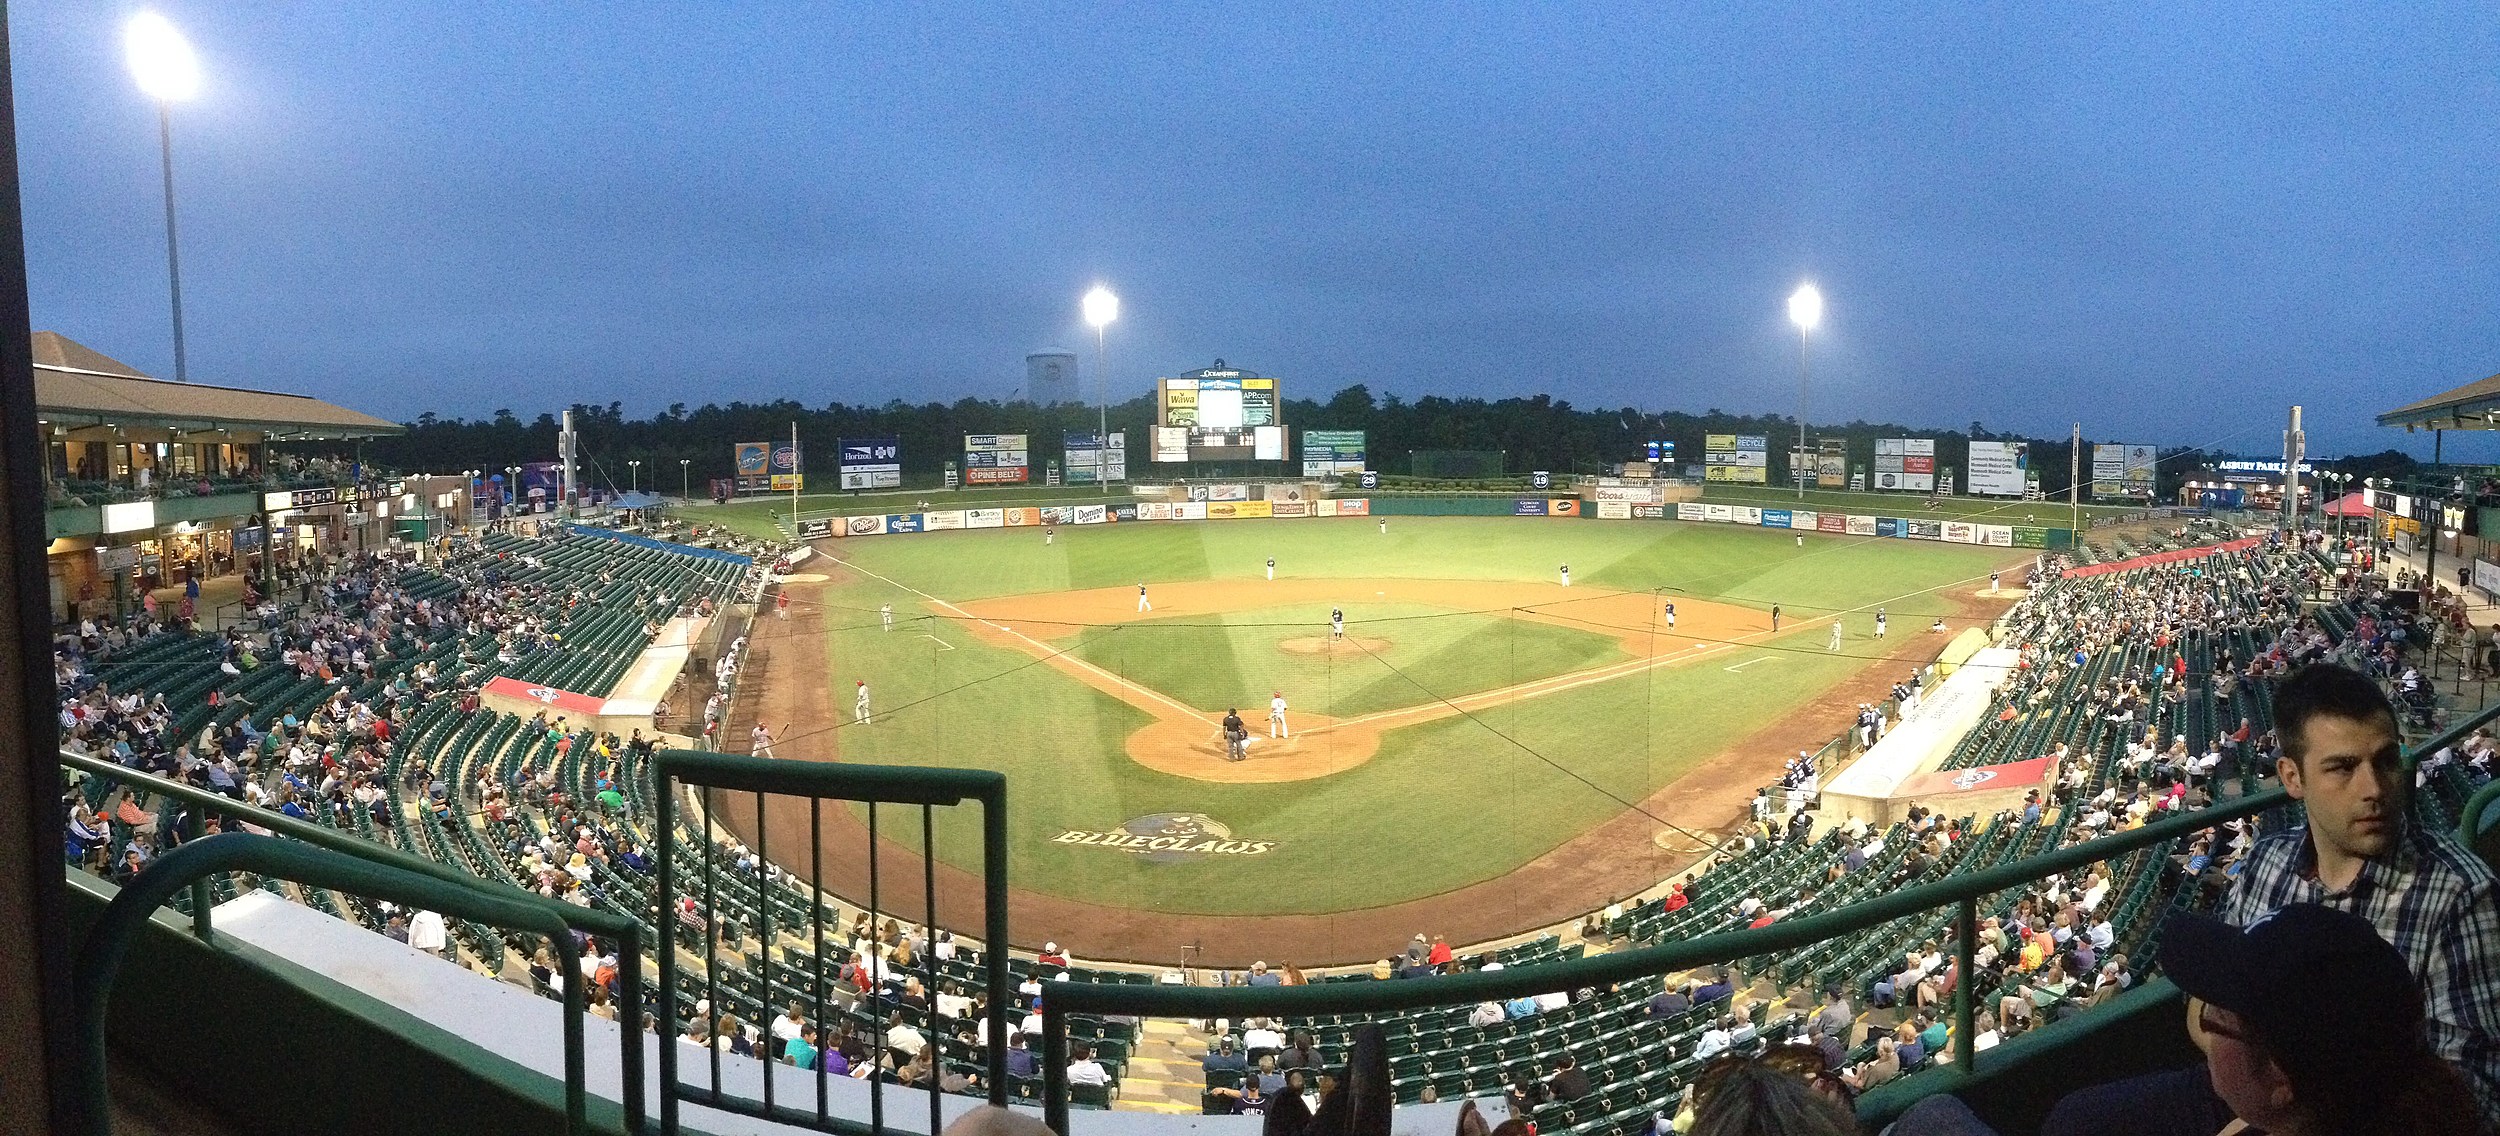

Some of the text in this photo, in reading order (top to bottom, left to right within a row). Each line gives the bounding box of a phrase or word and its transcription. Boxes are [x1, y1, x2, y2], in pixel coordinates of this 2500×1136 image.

[1171, 394, 1195, 404] Wawa
[1243, 392, 1272, 400] APP.com
[972, 437, 1019, 446] SMART Carpet
[1737, 439, 1767, 448] RECYCLE
[845, 452, 872, 461] Horizon
[1820, 464, 1843, 476] Coors
[2219, 461, 2255, 471] ASBURY
[2256, 462, 2281, 472] PARK
[977, 471, 1015, 479] PINE BELT
[1362, 475, 1375, 485] 29
[1535, 476, 1547, 485] 19
[1597, 490, 1624, 500] Coors
[1078, 507, 1104, 520] Domino
[892, 520, 917, 529] Corona
[1049, 829, 1282, 856] BLUECLAWS
